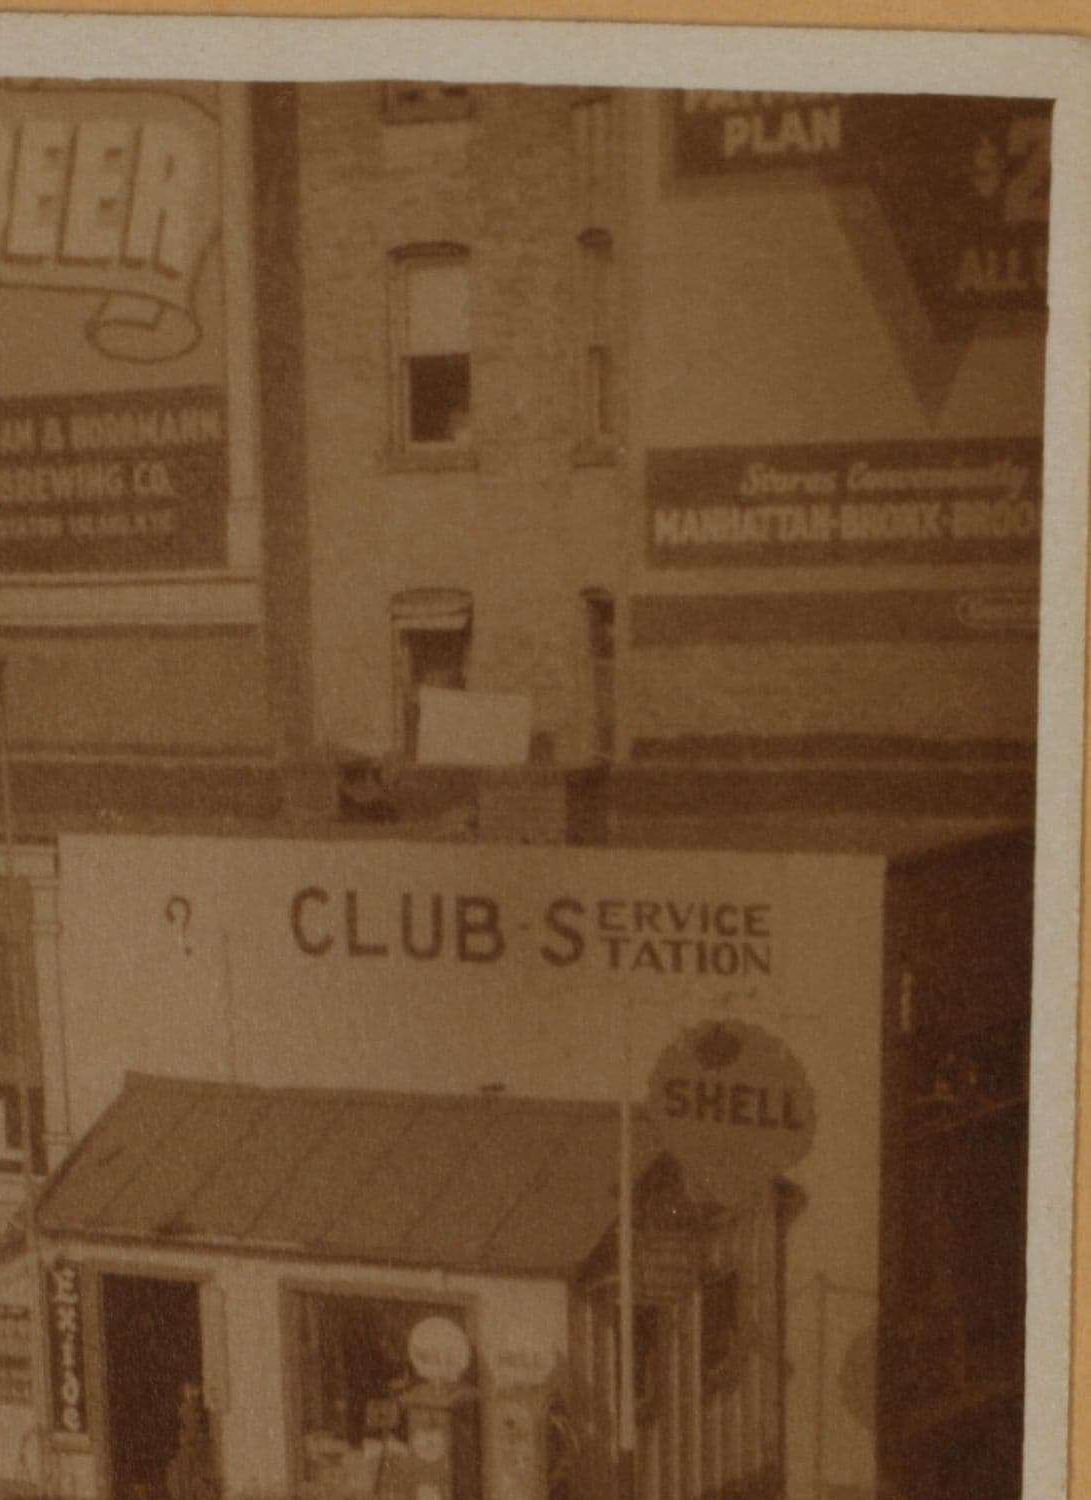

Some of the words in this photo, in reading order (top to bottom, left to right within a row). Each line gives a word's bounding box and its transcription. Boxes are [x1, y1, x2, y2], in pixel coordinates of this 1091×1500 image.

[725, 106, 843, 157] PLAN
[741, 461, 838, 496] Stores
[290, 887, 507, 964] CLUB
[662, 1076, 805, 1131] SHELL
[50, 1263, 82, 1433] Exide
